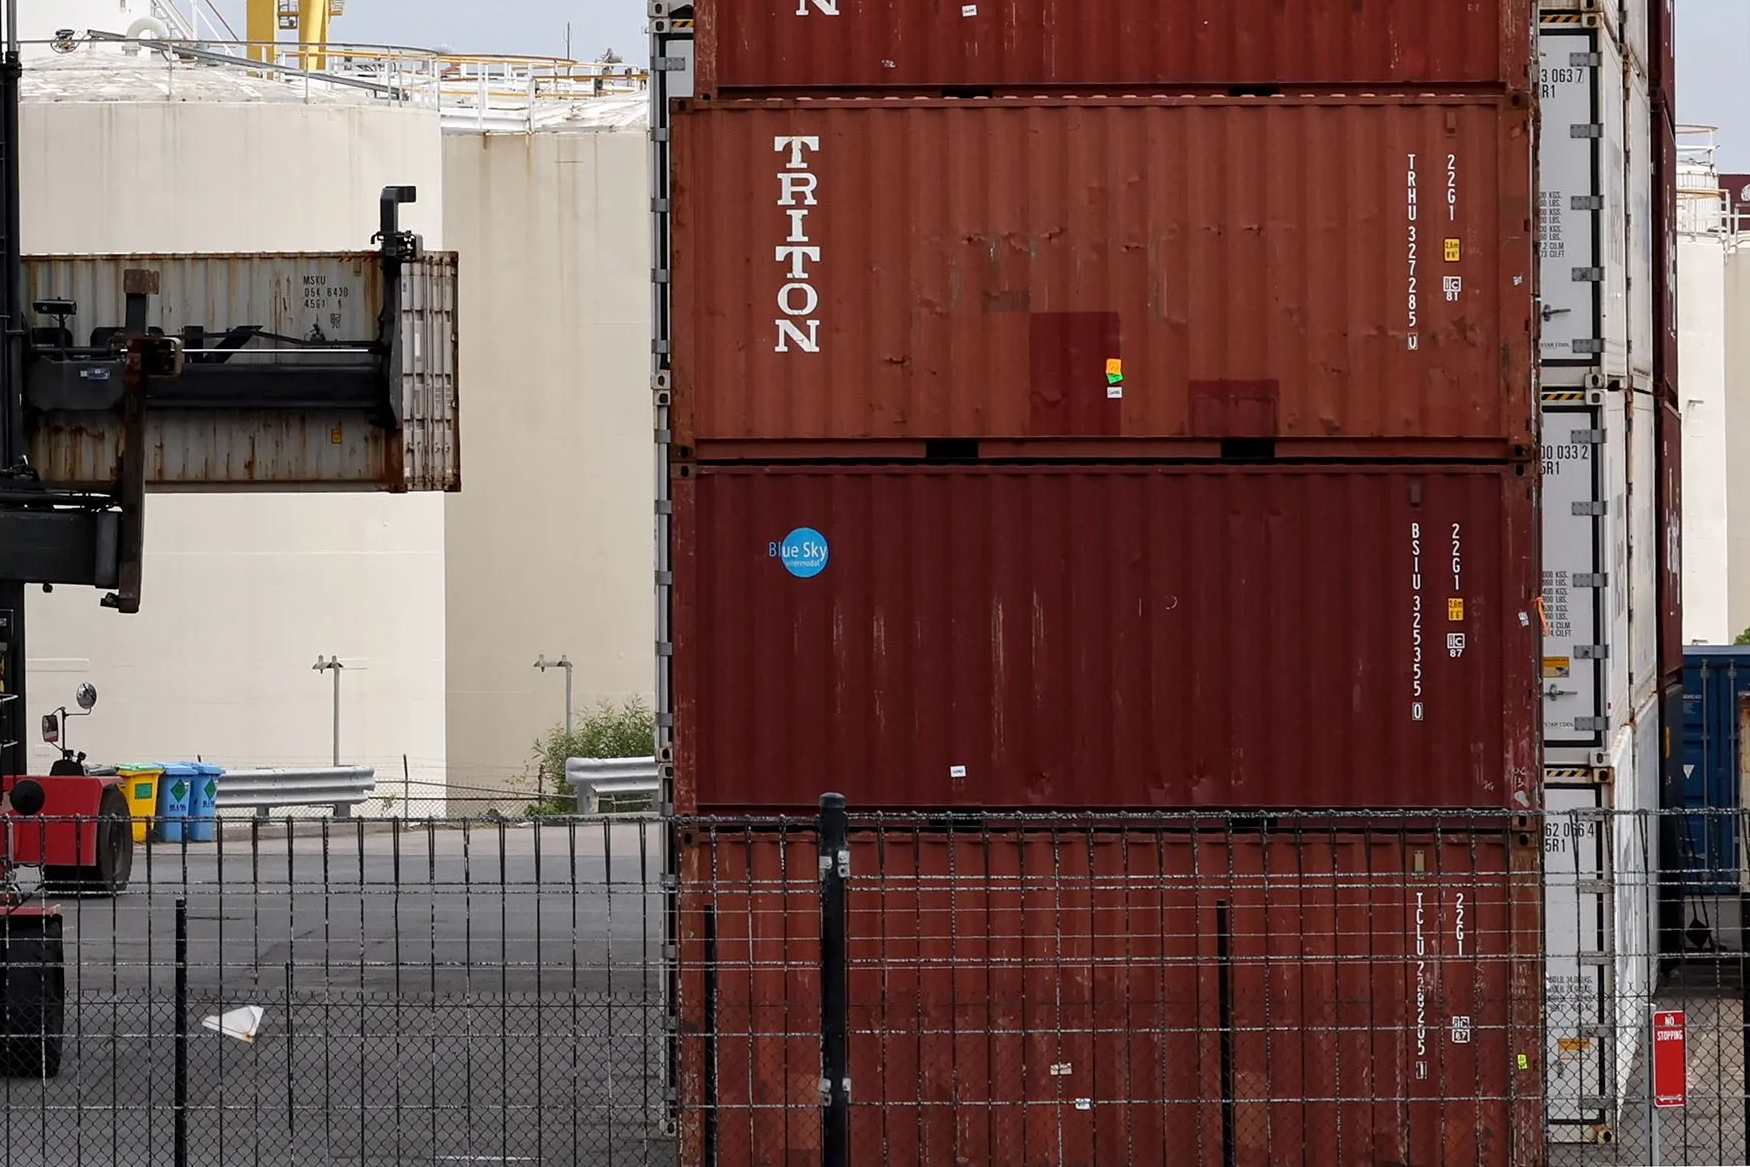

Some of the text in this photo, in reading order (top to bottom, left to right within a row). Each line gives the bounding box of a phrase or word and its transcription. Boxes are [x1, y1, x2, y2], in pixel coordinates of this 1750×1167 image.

[1551, 68, 1573, 82] 063
[1576, 68, 1583, 82] 7
[1542, 85, 1556, 98] R1
[1447, 154, 1456, 221] 22G1
[774, 136, 820, 353] TRITON
[1407, 154, 1417, 327] TRHU 327285
[303, 275, 326, 285] MSKU
[304, 286, 349, 297] 054 6430
[1446, 291, 1458, 301] 81
[1556, 445, 1588, 459] 033 2
[769, 541, 827, 561] Blue Sky
[1452, 523, 1460, 590] 22G1
[1411, 523, 1422, 718] BSIU 325355 0
[1449, 649, 1462, 657] 87
[1587, 822, 1594, 835] 4
[1545, 838, 1566, 853] 5R1
[1416, 892, 1424, 956] TCLU
[1456, 893, 1464, 956] 22G1
[1665, 1016, 1674, 1025] NO
[1455, 1031, 1467, 1040] 87
[1657, 1030, 1683, 1041] STOPPING
